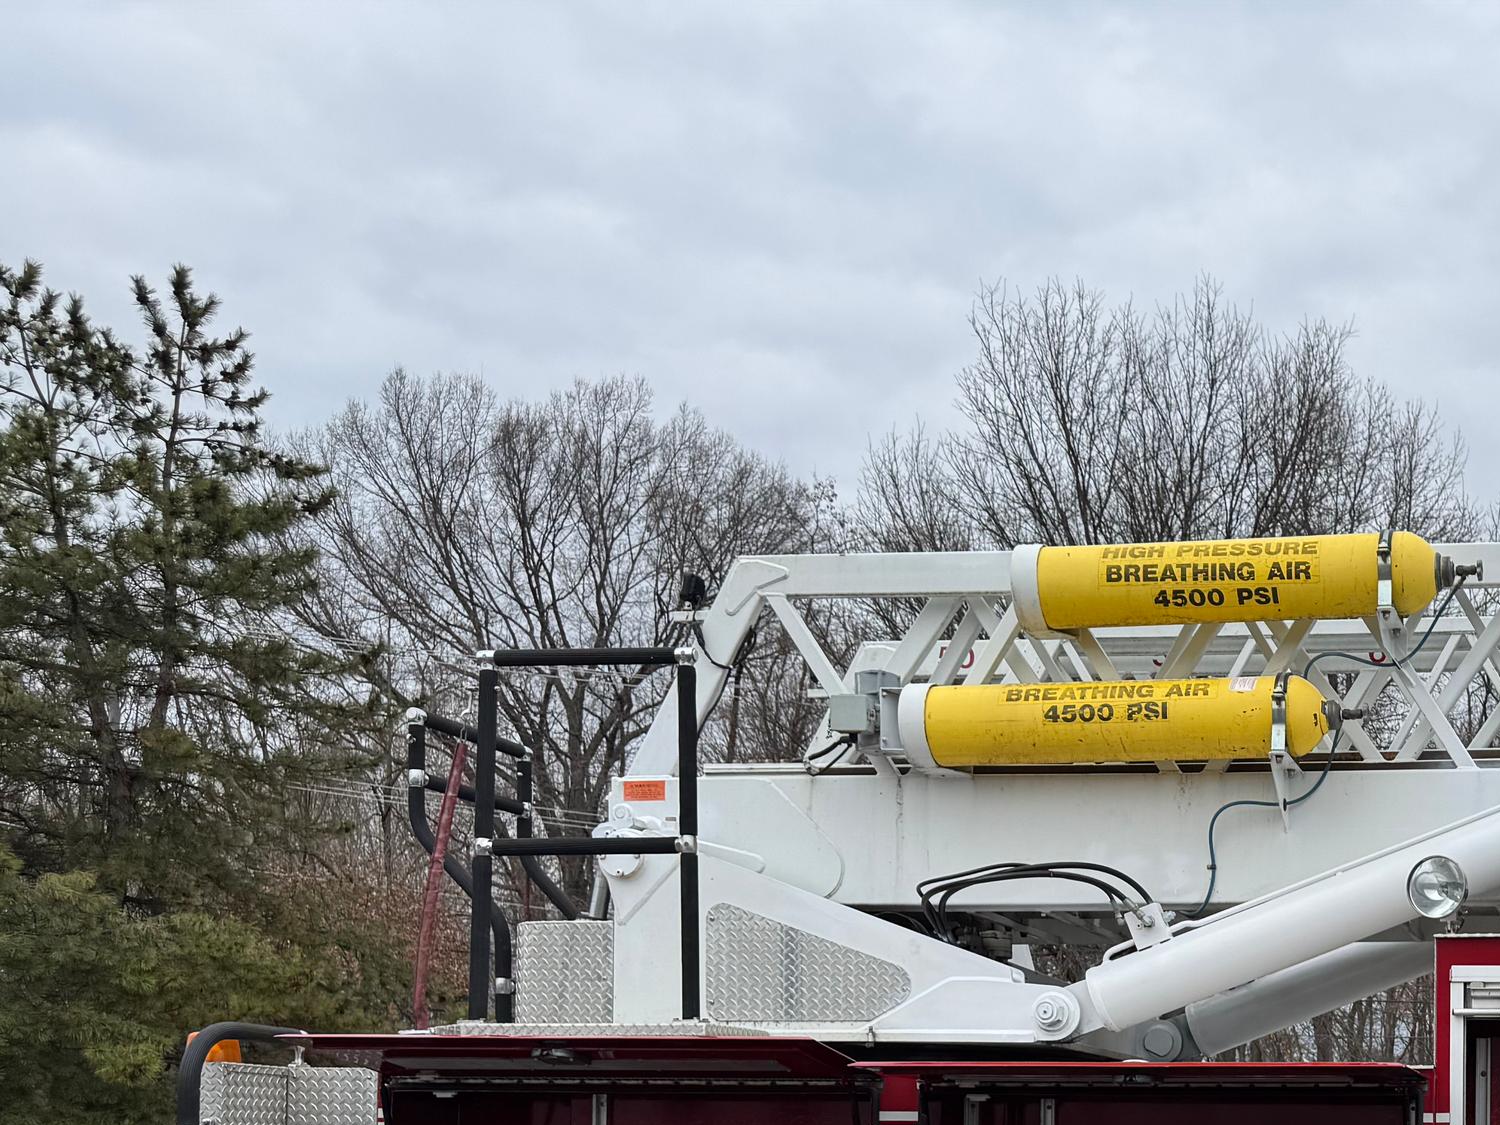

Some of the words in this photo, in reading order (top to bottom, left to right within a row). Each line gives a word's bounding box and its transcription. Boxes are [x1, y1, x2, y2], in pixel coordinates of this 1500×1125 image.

[1101, 545, 1165, 559] HIGH
[1175, 541, 1319, 558] PRESSURE
[1105, 562, 1256, 583] BREATHING
[1267, 561, 1312, 581] AIR
[1154, 588, 1225, 607] 4500
[1236, 586, 1280, 606] PSI
[1005, 684, 1154, 702] BREATHING
[1164, 683, 1210, 698] AIR
[1043, 703, 1114, 723] 4500
[1126, 701, 1168, 721] PSI
